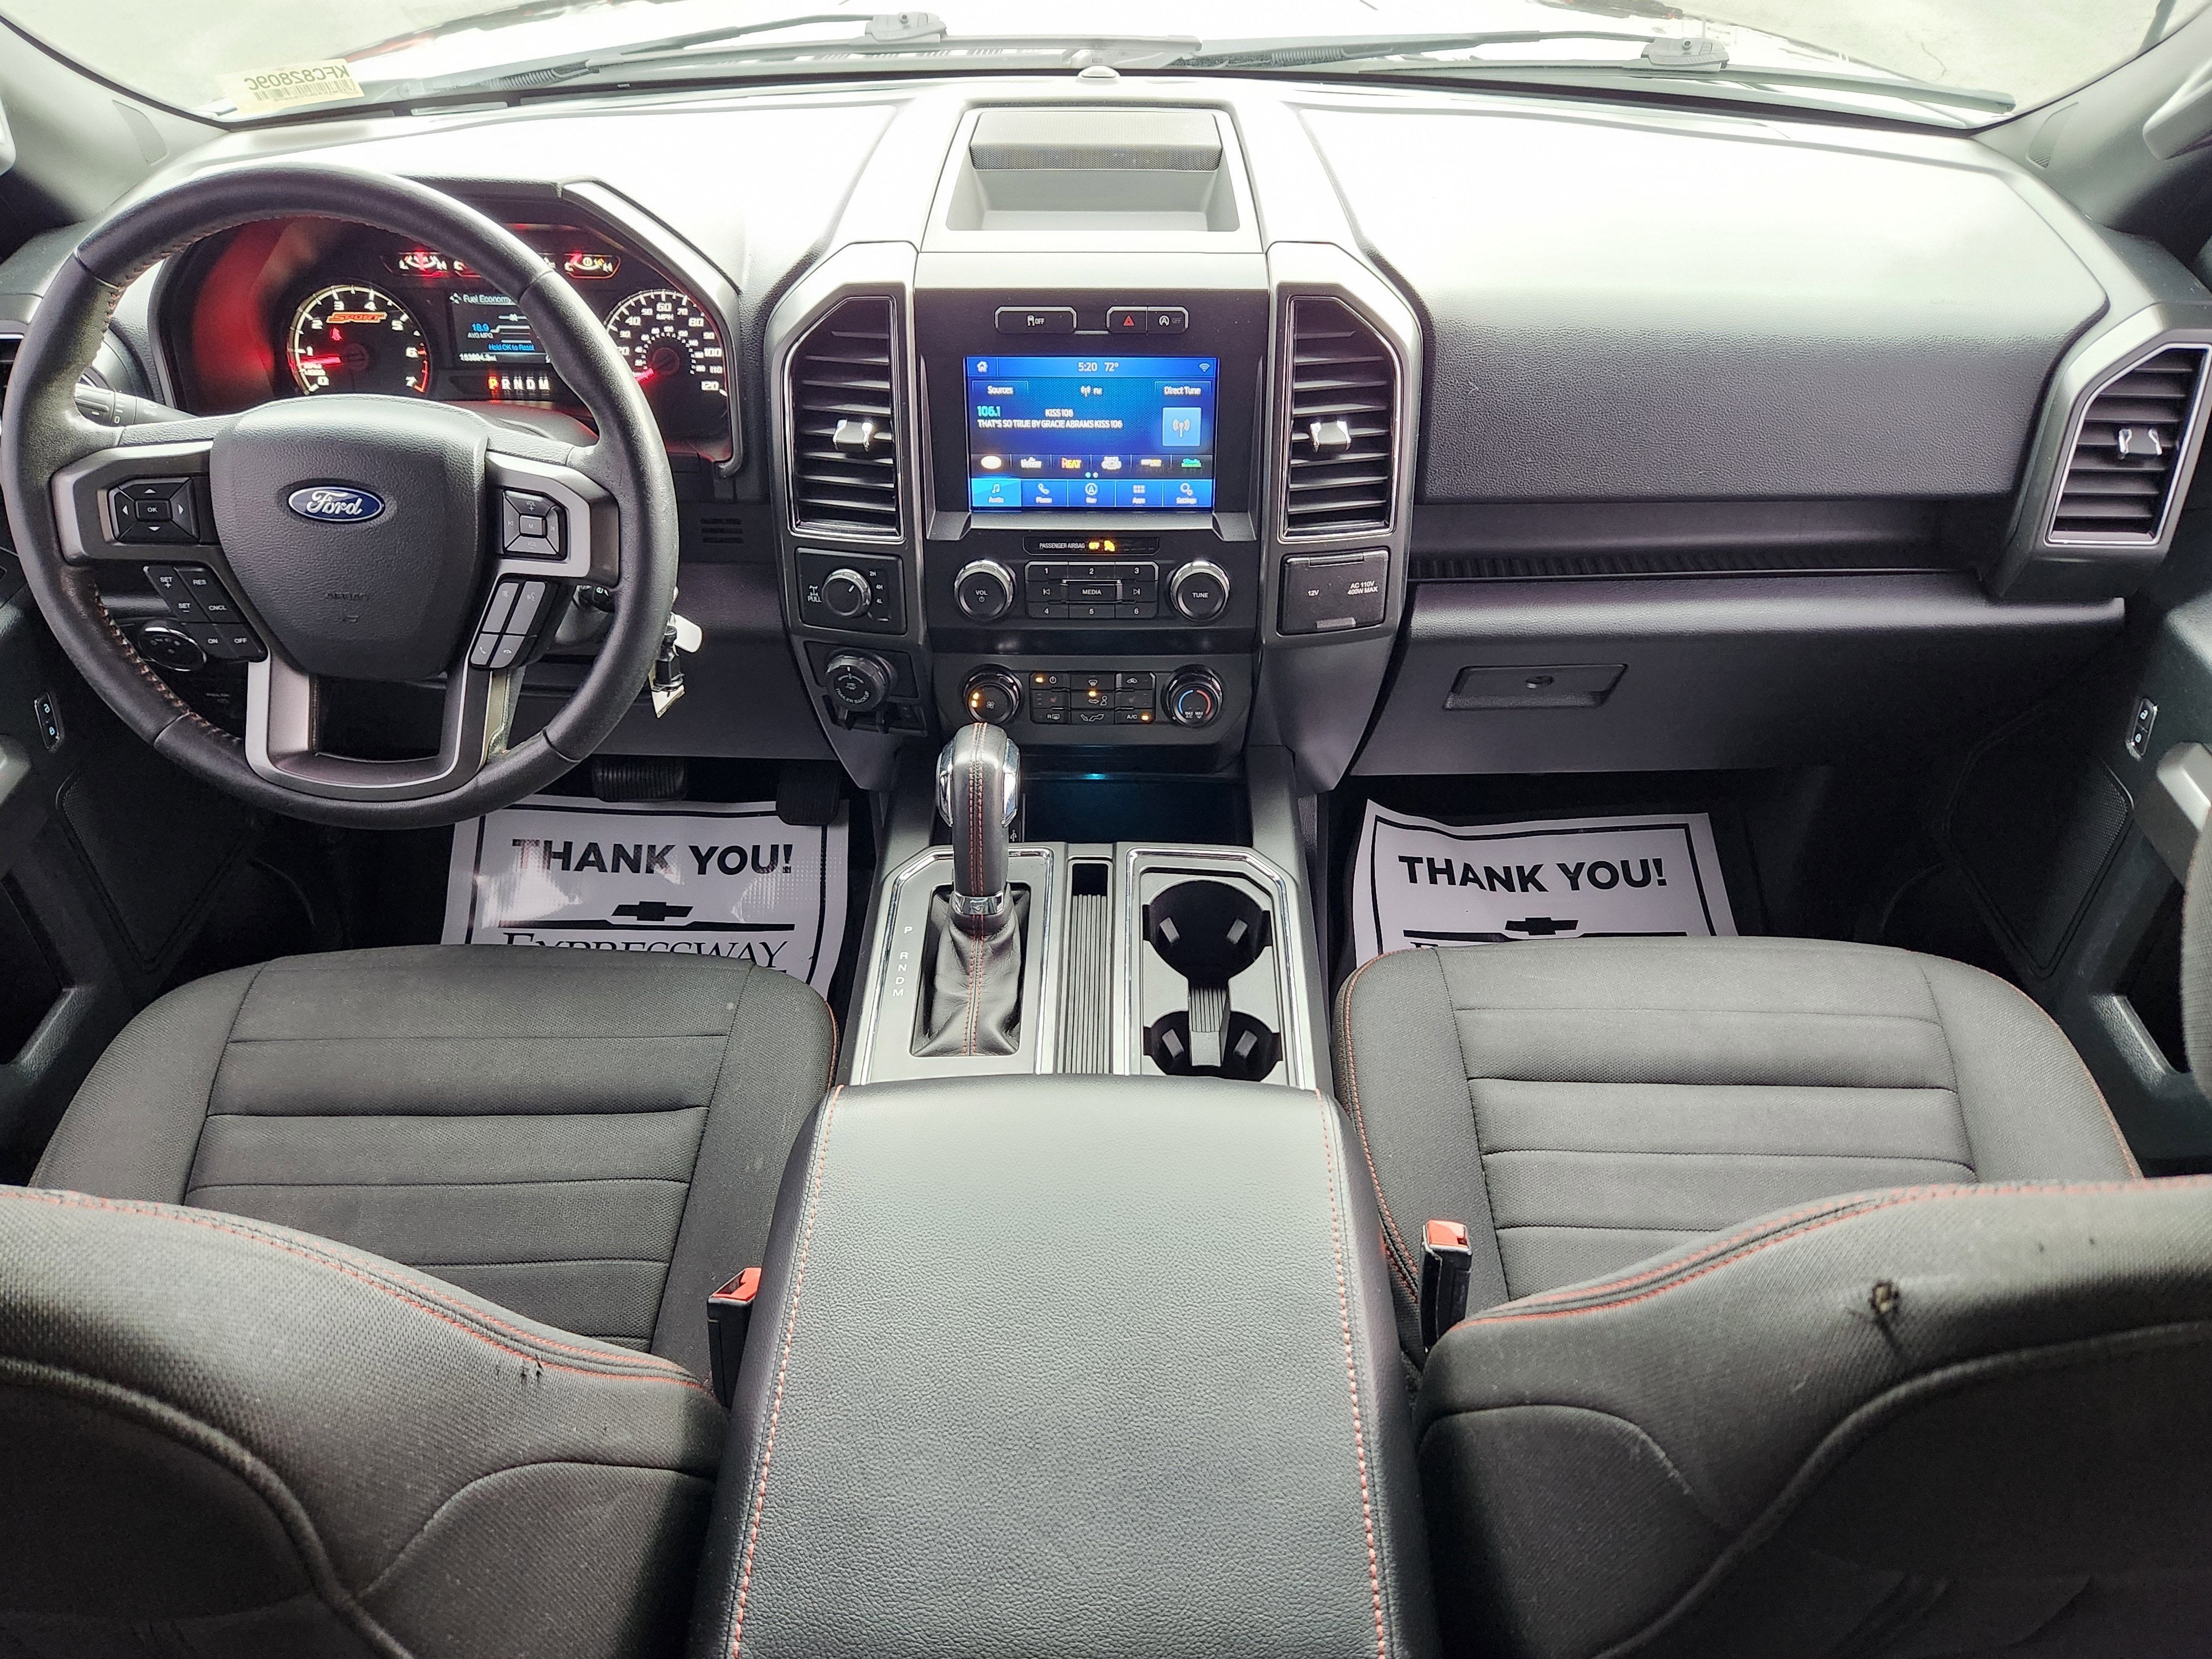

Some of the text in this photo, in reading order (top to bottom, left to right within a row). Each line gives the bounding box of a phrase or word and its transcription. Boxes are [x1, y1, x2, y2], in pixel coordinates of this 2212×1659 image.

[463, 294, 512, 304] Fuel Economy
[334, 300, 345, 310] 3
[364, 300, 377, 311] 4
[656, 302, 672, 312] 60
[641, 307, 653, 316] 50
[676, 307, 688, 316] 70
[327, 312, 387, 322] SPORT
[625, 316, 641, 326] 40
[688, 317, 704, 327] 80
[311, 319, 323, 330] 2
[392, 319, 404, 331] 5
[472, 323, 489, 332] 18.9
[619, 330, 631, 338] 30
[703, 332, 715, 340] 90
[306, 346, 313, 356] 1
[405, 347, 418, 358] 6
[617, 346, 630, 356] 20
[703, 347, 722, 357] 100
[709, 365, 723, 374] 110
[1078, 362, 1119, 372] 5:20 72°
[317, 376, 330, 386] 0
[405, 375, 416, 387] 7
[488, 378, 498, 390] P
[502, 378, 511, 390] R
[514, 378, 524, 390] N
[526, 378, 536, 390] D
[538, 378, 550, 390] M
[701, 380, 719, 391] 120
[987, 385, 1014, 395] Sources
[1164, 385, 1202, 395] Direct Tune
[977, 405, 1001, 417] 106.1
[1045, 408, 1074, 418] KISS 106
[977, 419, 1123, 429] THAT'S SO TRUE BY GRACIE ABRAMS KISS 106
[306, 490, 363, 515] Ford
[834, 687, 870, 704] TRAILER BACKUP
[512, 838, 794, 875] THANK YOU!
[1398, 855, 1668, 893] THANK YOU!
[904, 926, 913, 934] P
[892, 988, 904, 997] M
